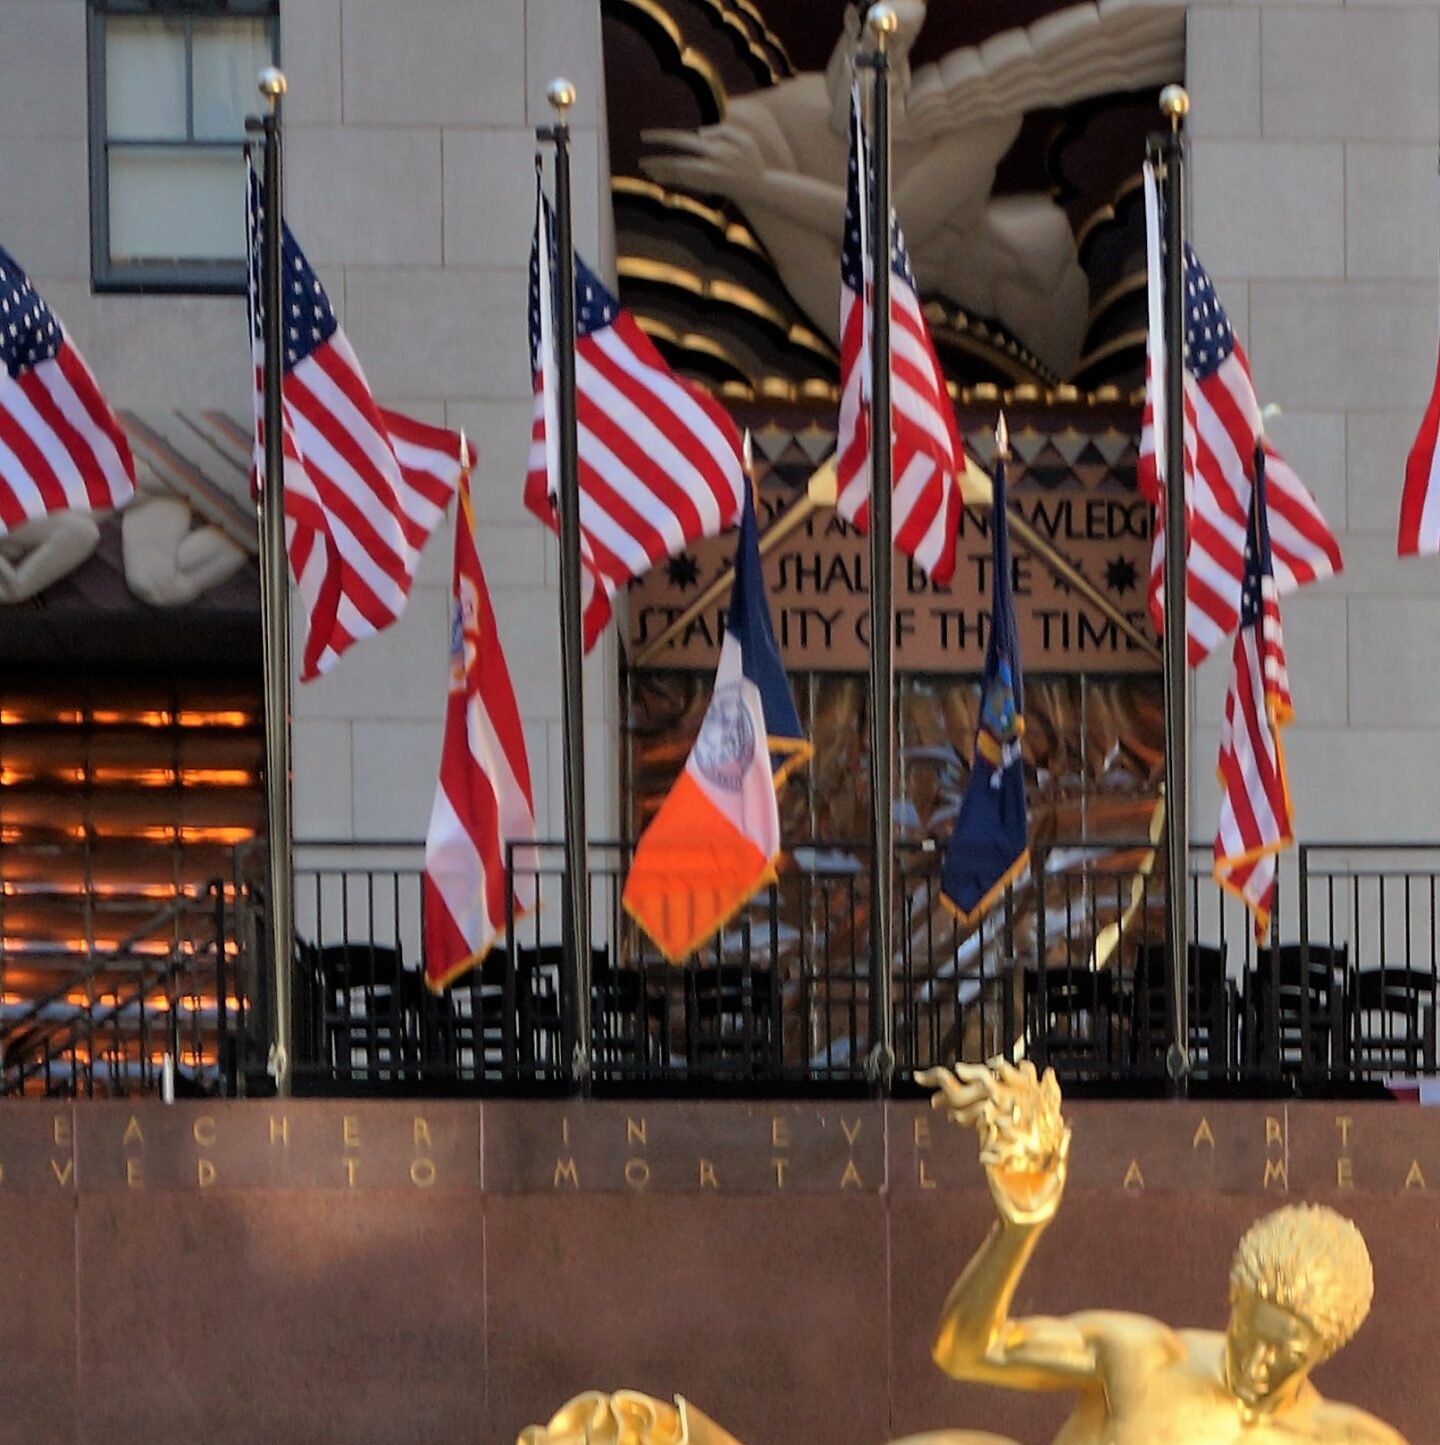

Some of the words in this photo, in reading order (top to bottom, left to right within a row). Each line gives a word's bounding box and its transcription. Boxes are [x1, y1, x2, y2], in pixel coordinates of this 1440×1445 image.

[771, 553, 871, 593] SHAL
[968, 554, 1032, 594] TE
[929, 608, 993, 650] TH
[562, 1116, 647, 1147] IN
[771, 1116, 933, 1148] EVE
[1192, 1115, 1352, 1149] ART
[0, 1157, 216, 1189] VED
[341, 1156, 436, 1189] TO
[553, 1156, 937, 1190] MORTAL
[1122, 1157, 1146, 1189] A
